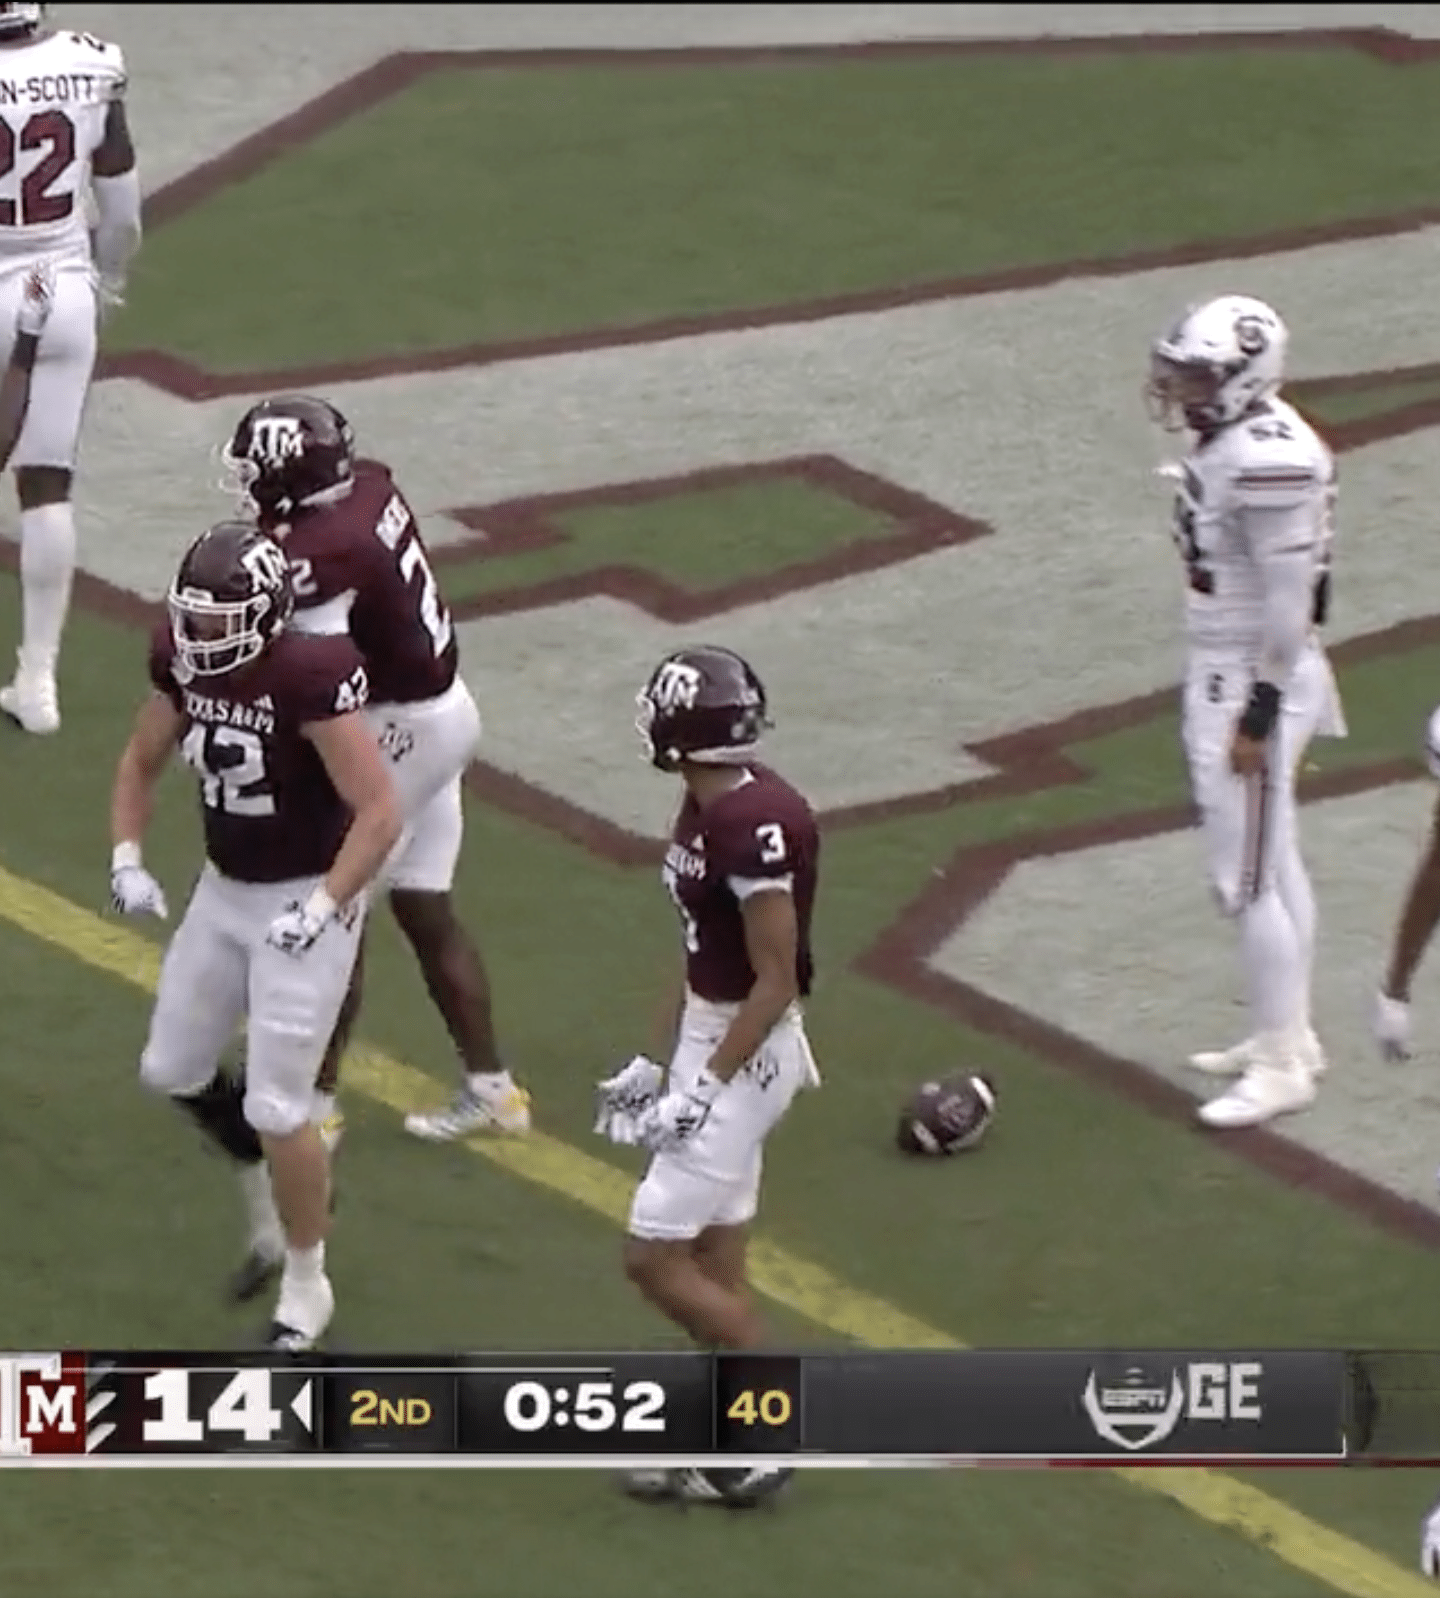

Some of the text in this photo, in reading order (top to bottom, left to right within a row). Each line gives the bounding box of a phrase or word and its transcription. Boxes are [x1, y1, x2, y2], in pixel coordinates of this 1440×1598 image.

[291, 559, 318, 595] 2
[334, 665, 368, 712] 42
[182, 722, 276, 817] 42
[755, 822, 786, 864] 3
